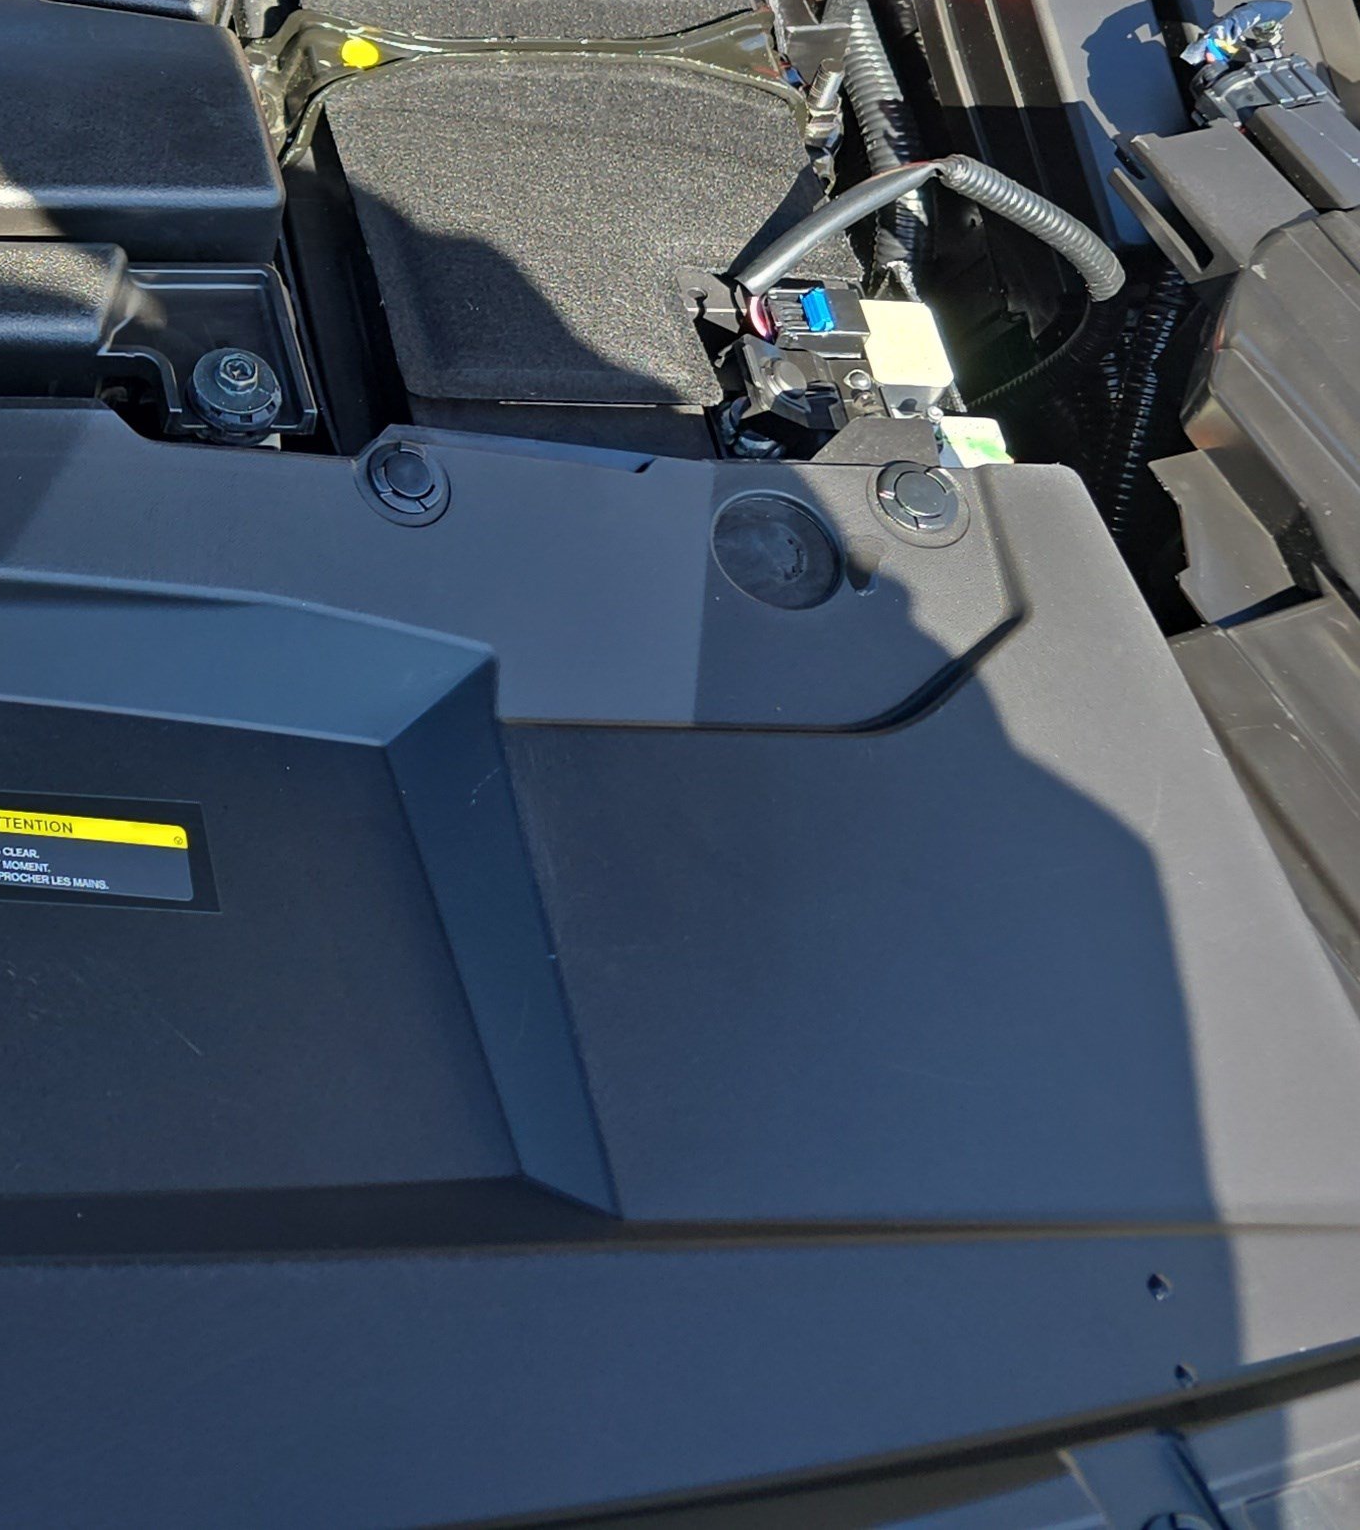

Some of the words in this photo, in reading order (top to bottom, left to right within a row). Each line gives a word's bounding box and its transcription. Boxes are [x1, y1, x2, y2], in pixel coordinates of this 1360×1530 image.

[2, 847, 39, 859] CLEAR.
[2, 861, 51, 873] MOMENT.
[51, 876, 71, 887] LES
[73, 878, 109, 890] MAINS.
